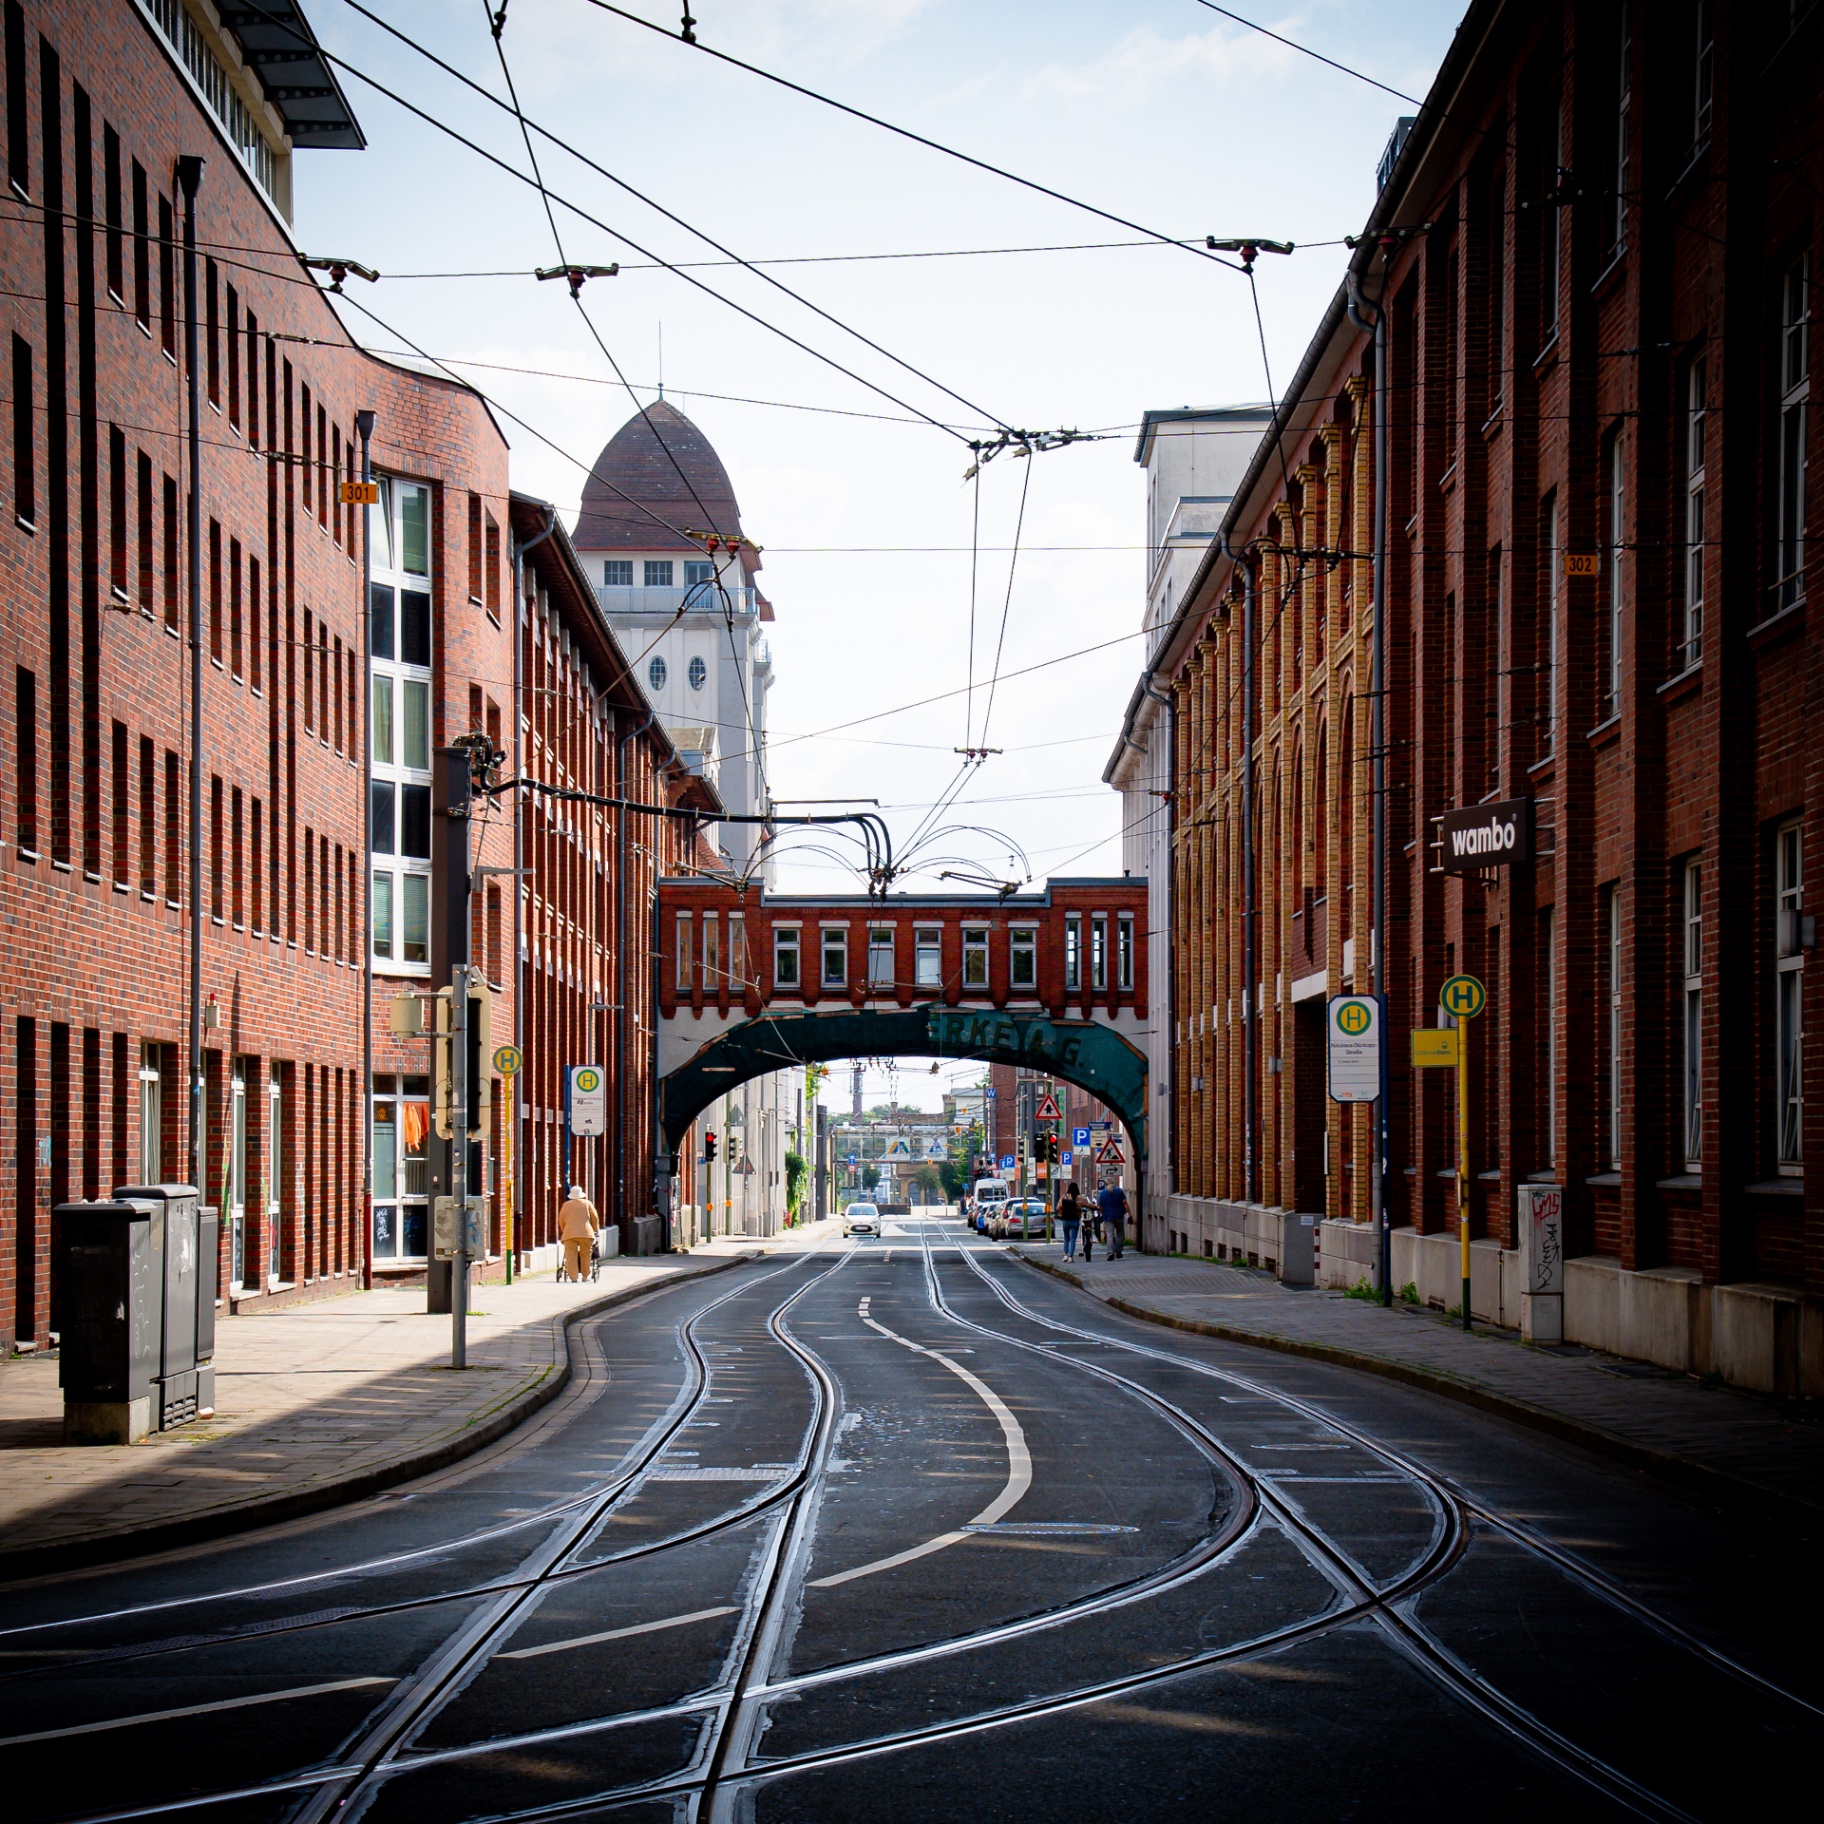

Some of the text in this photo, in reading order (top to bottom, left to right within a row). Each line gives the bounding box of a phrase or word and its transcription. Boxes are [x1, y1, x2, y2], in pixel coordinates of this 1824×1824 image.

[347, 485, 369, 500] 301
[1569, 557, 1592, 572] 302
[1452, 816, 1515, 856] wambo
[1453, 986, 1473, 1009] H
[1346, 1009, 1360, 1028] H
[501, 1053, 514, 1068] H
[1077, 1130, 1087, 1144] P
